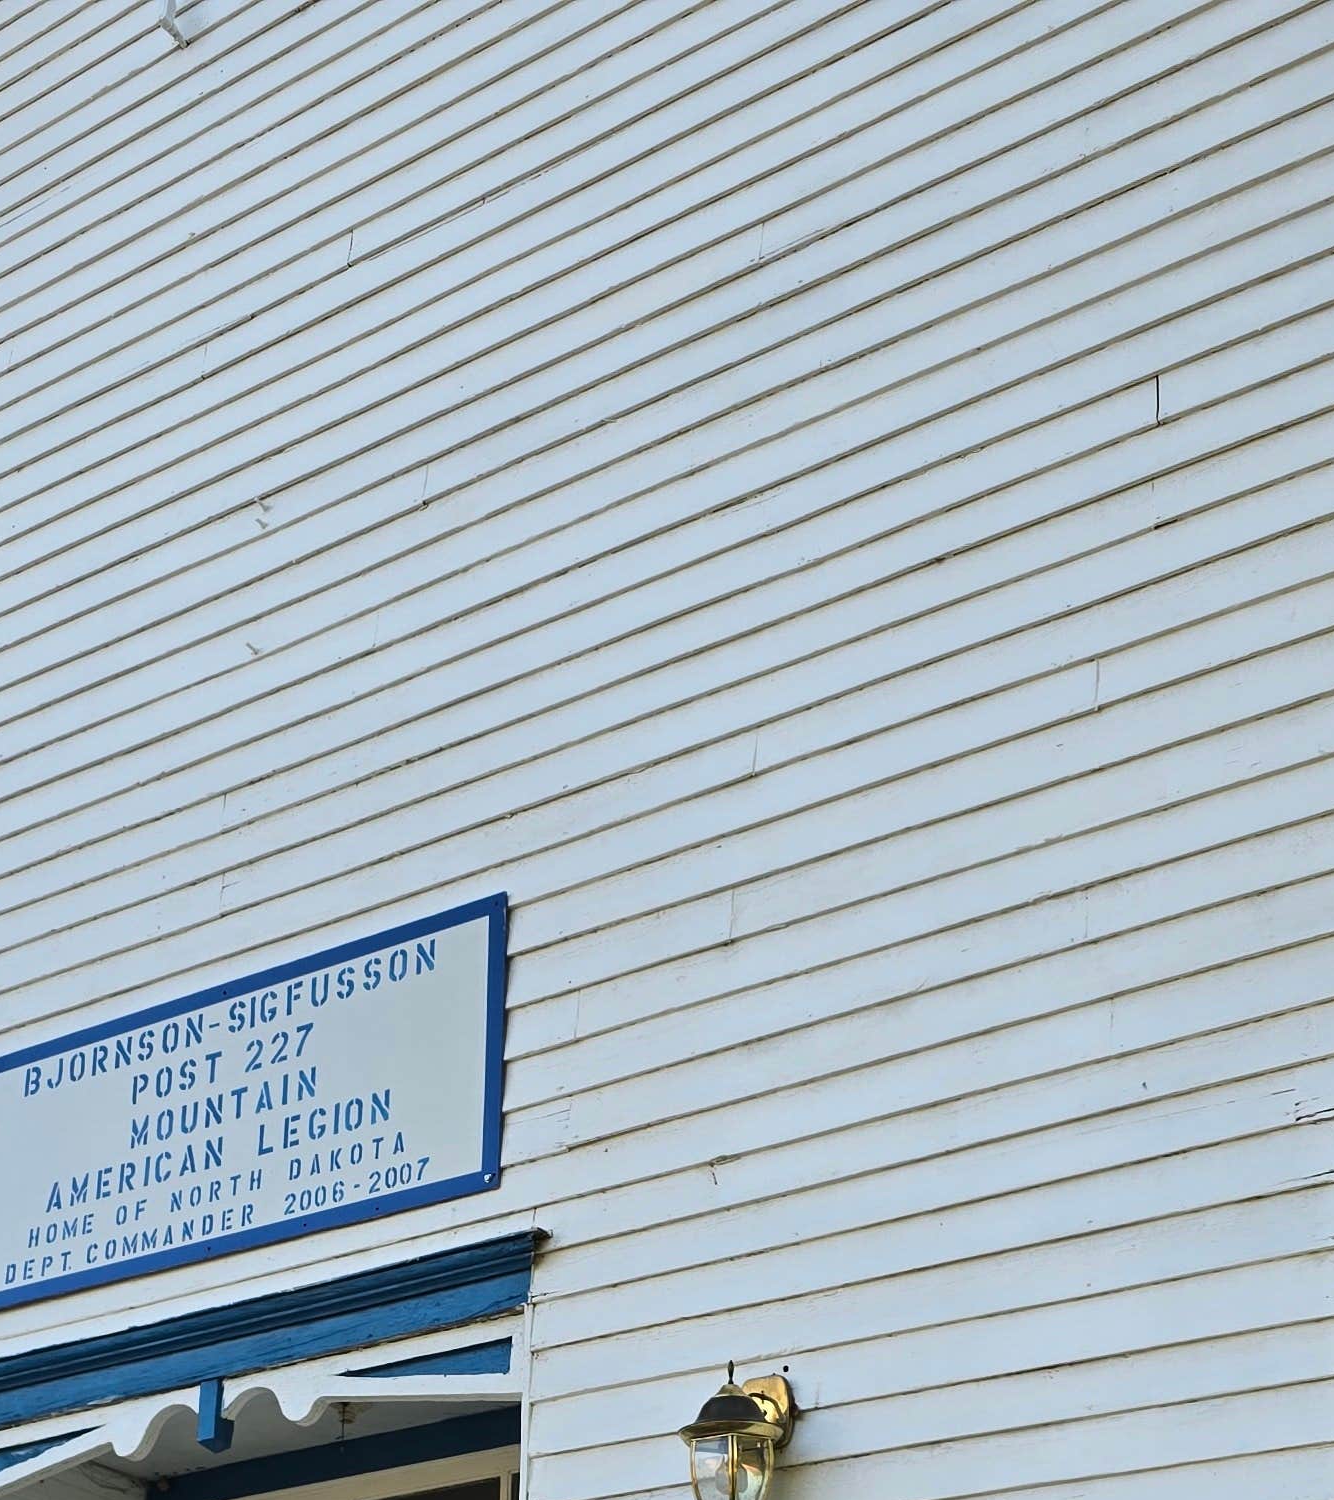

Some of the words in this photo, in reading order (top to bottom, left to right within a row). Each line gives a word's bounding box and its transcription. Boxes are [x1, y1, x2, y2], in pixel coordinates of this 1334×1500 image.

[24, 939, 437, 1098] BJORNSON-SIGFUSSON
[132, 1051, 223, 1104] POST
[244, 1022, 315, 1073] 227
[45, 1137, 224, 1213] AMERICAN
[258, 1089, 392, 1155] LEGION
[130, 1066, 317, 1149] MOUNTAIN
[29, 1214, 94, 1248] HOME
[115, 1201, 148, 1225] OF
[170, 1169, 262, 1212] NORTH
[289, 1132, 405, 1180] DAKOTA
[86, 1204, 255, 1264] COMMANDER
[284, 1157, 430, 1215] 2006-2007
